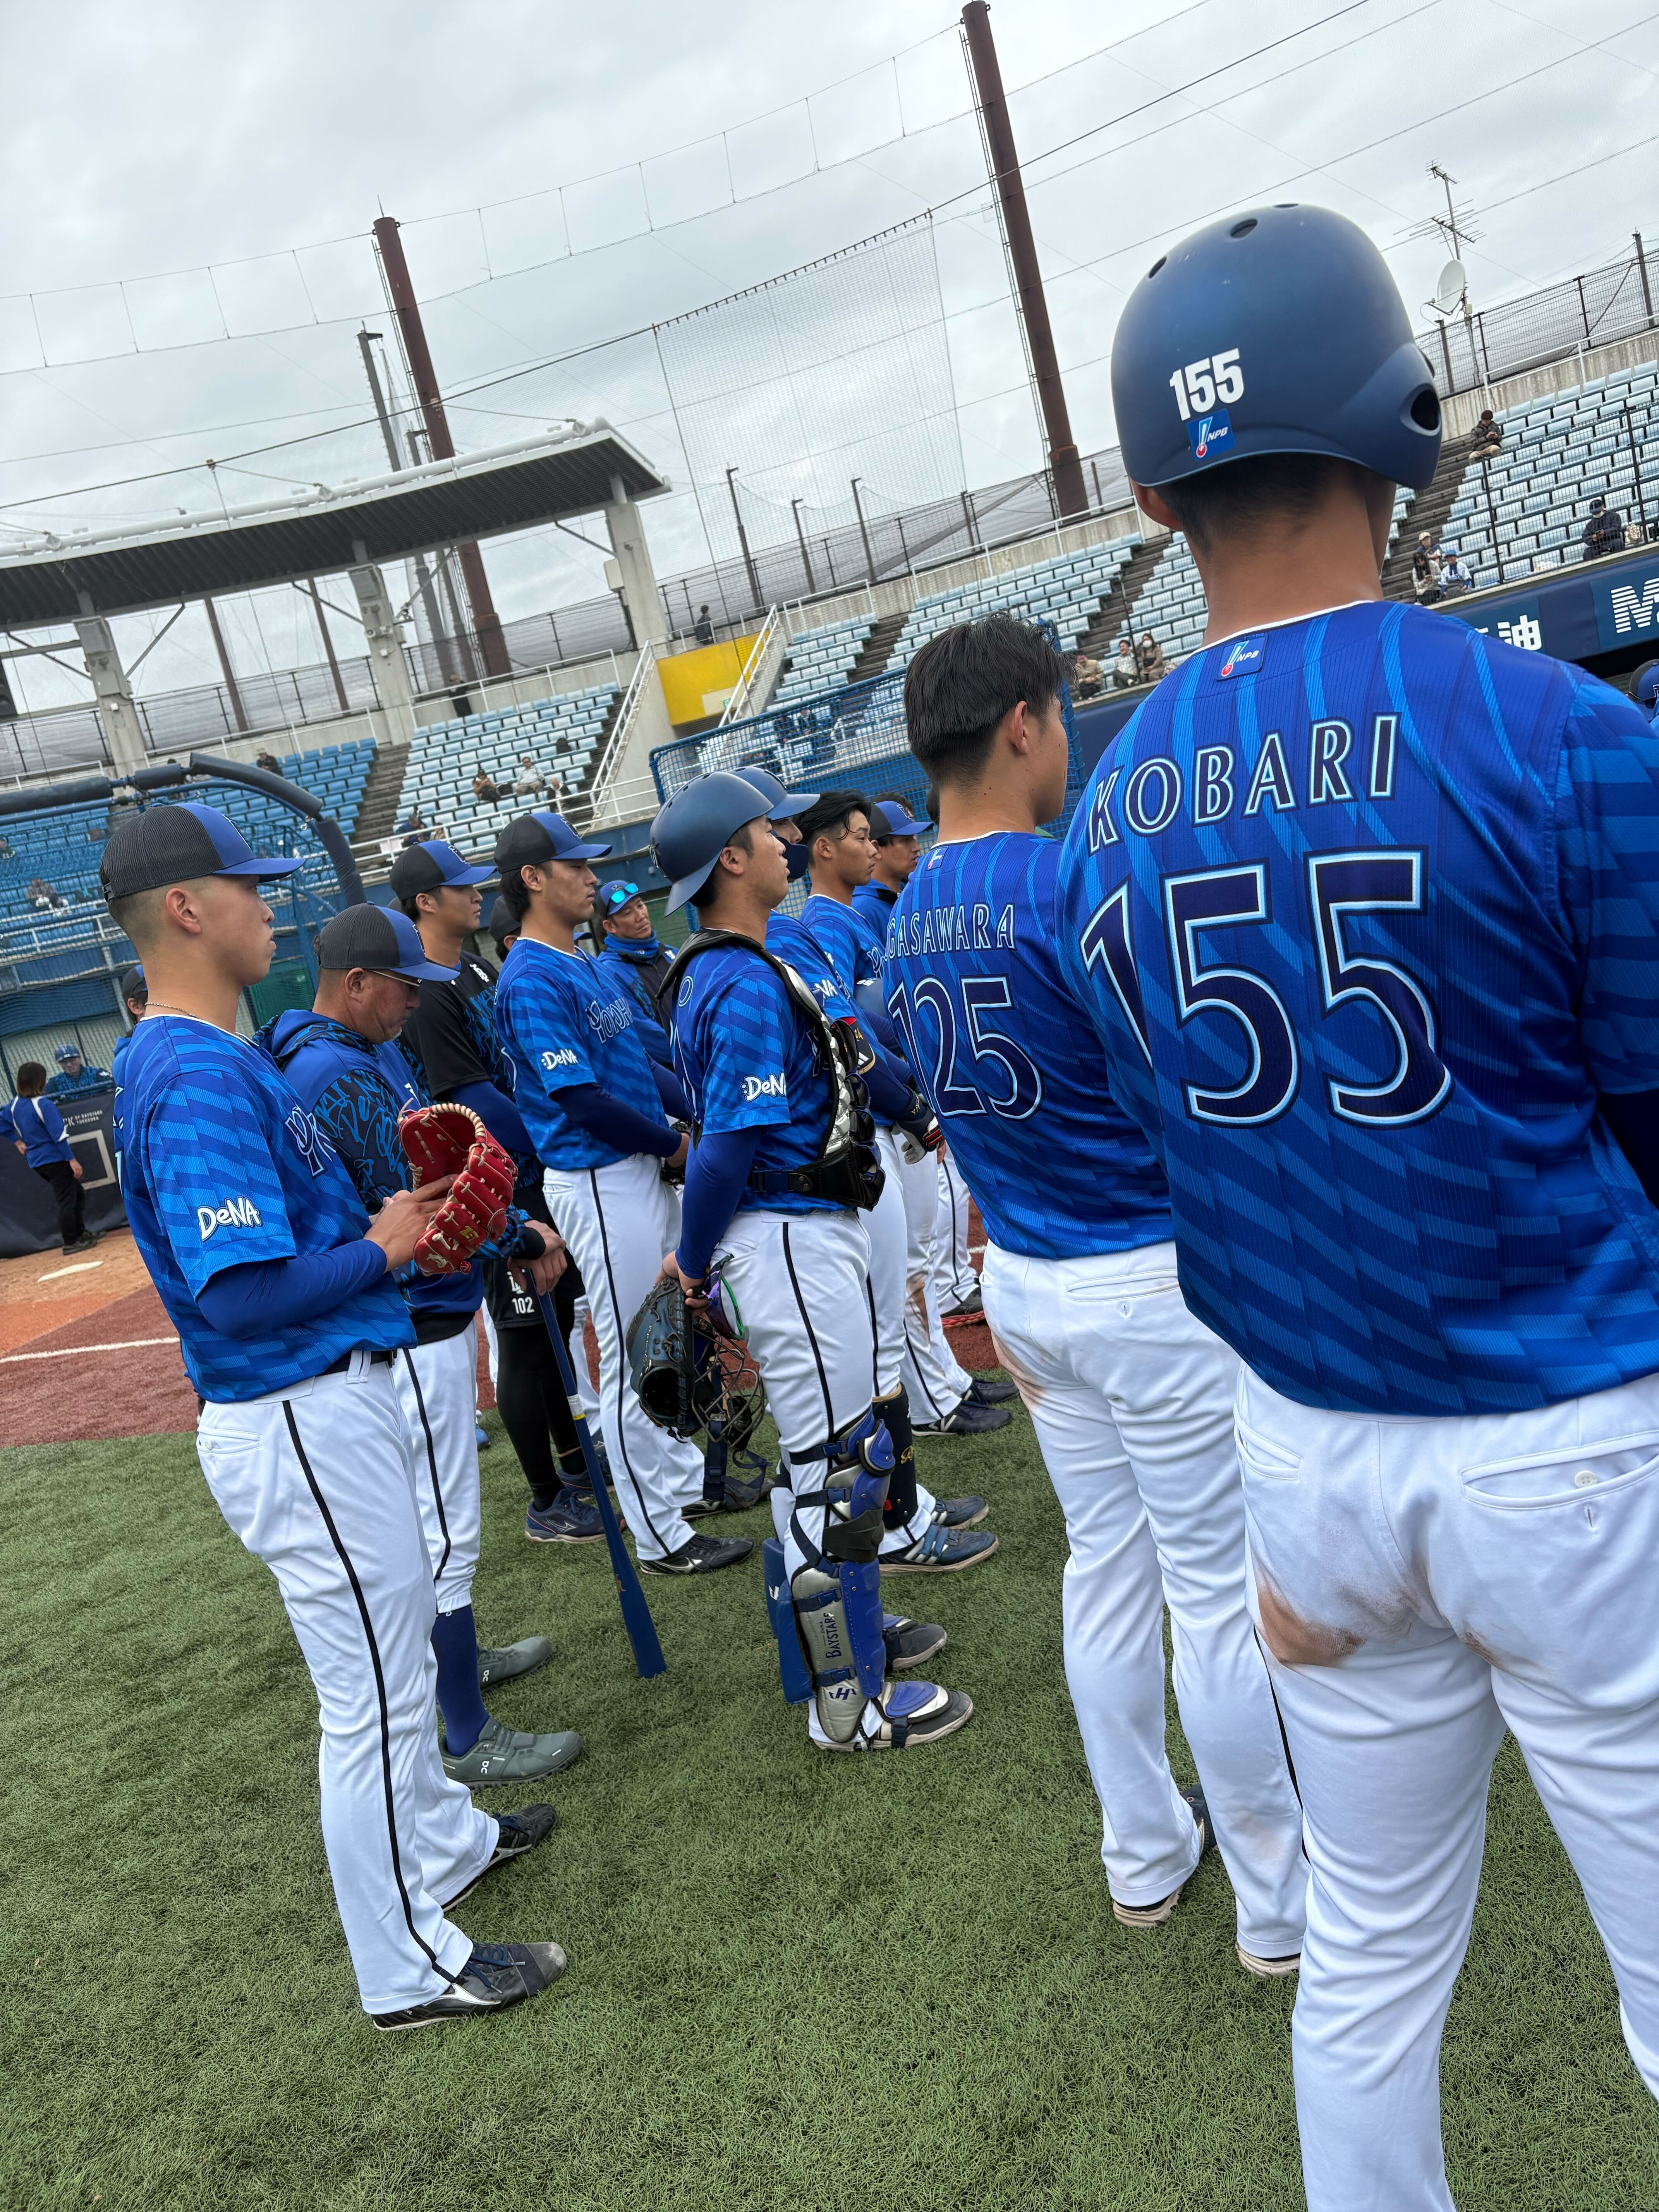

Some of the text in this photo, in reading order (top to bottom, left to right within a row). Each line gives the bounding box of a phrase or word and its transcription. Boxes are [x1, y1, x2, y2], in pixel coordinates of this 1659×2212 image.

[1170, 348, 1244, 421] 155
[1207, 426, 1228, 441] NPB
[1475, 615, 1542, 651] 油
[1611, 578, 1659, 633] M
[1236, 650, 1259, 662] NPB
[1089, 714, 1400, 855] KOBARI
[885, 903, 1015, 960] GASAWARA
[1080, 849, 1453, 1126] 155
[888, 976, 1042, 1120] 125
[197, 1195, 262, 1242] DeNA
[512, 1297, 534, 1314] 102
